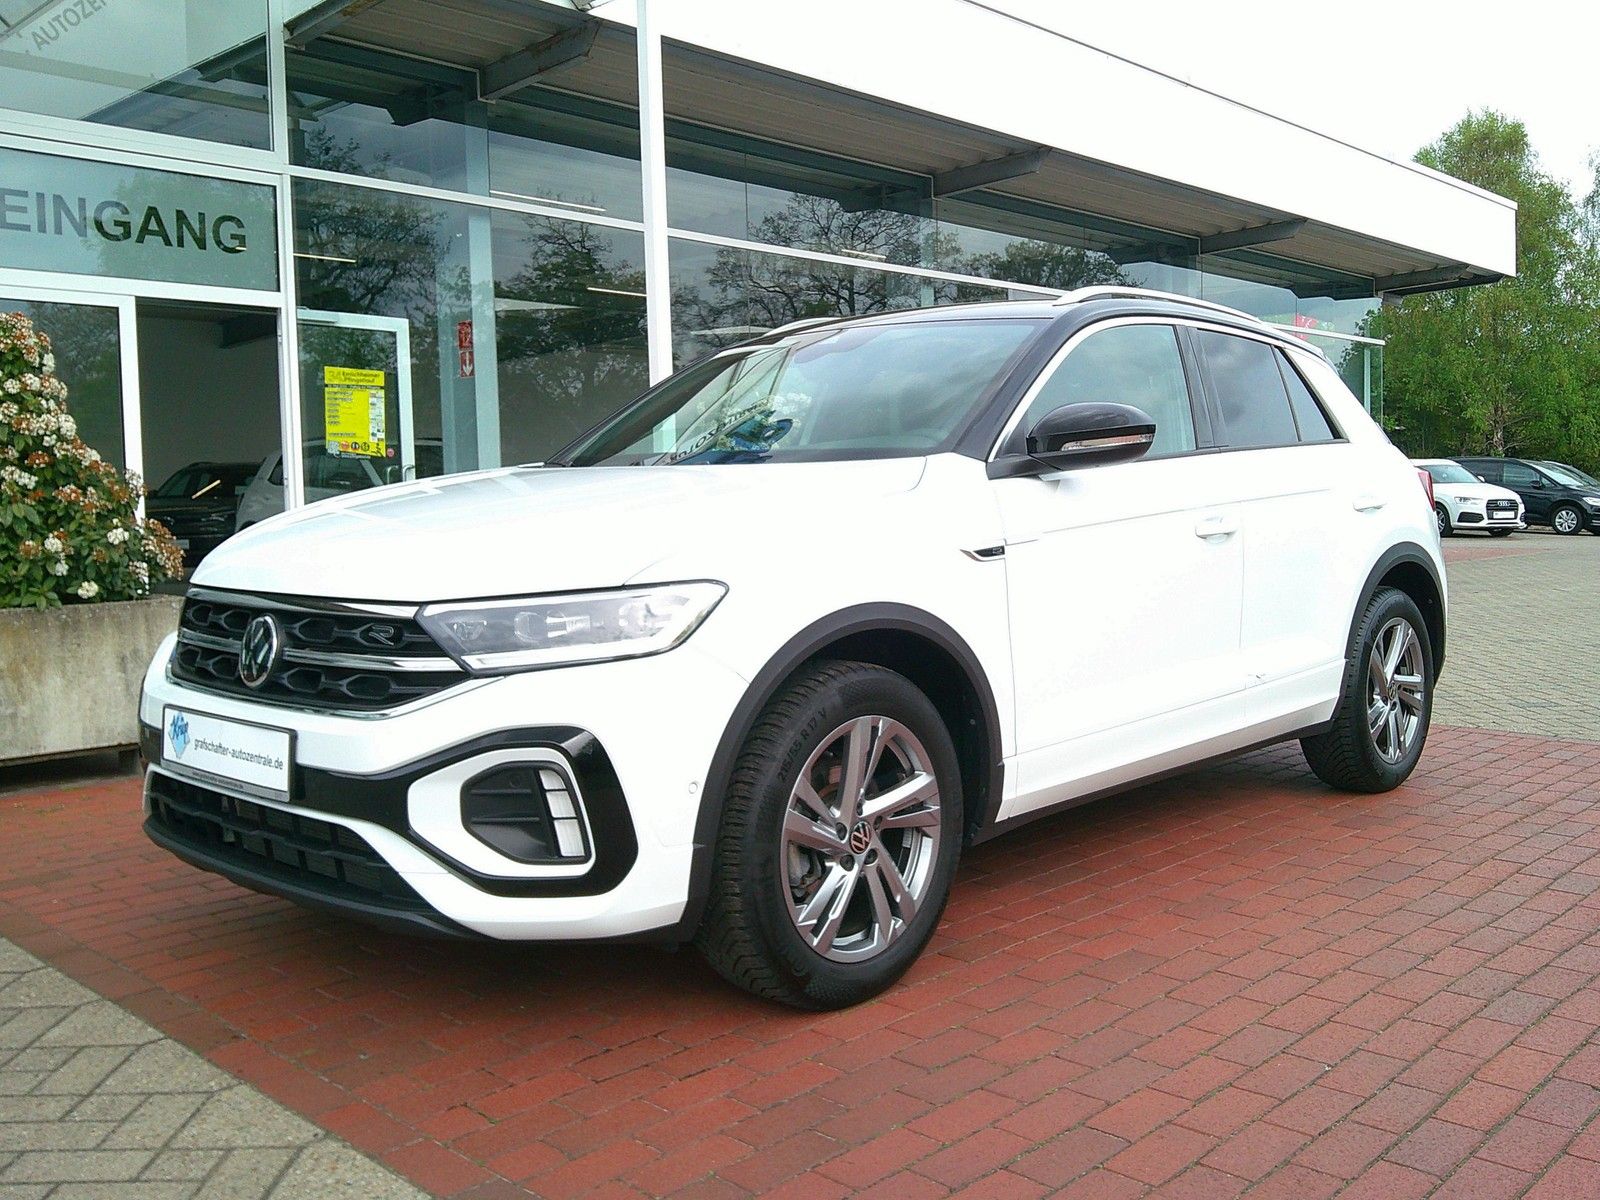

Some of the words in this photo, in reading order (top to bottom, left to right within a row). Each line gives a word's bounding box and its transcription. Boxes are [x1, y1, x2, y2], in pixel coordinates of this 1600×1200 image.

[31, 0, 106, 50] AUTOZE
[0, 187, 248, 254] EINGANG
[194, 738, 284, 770] grafschafter-autozentrale.de
